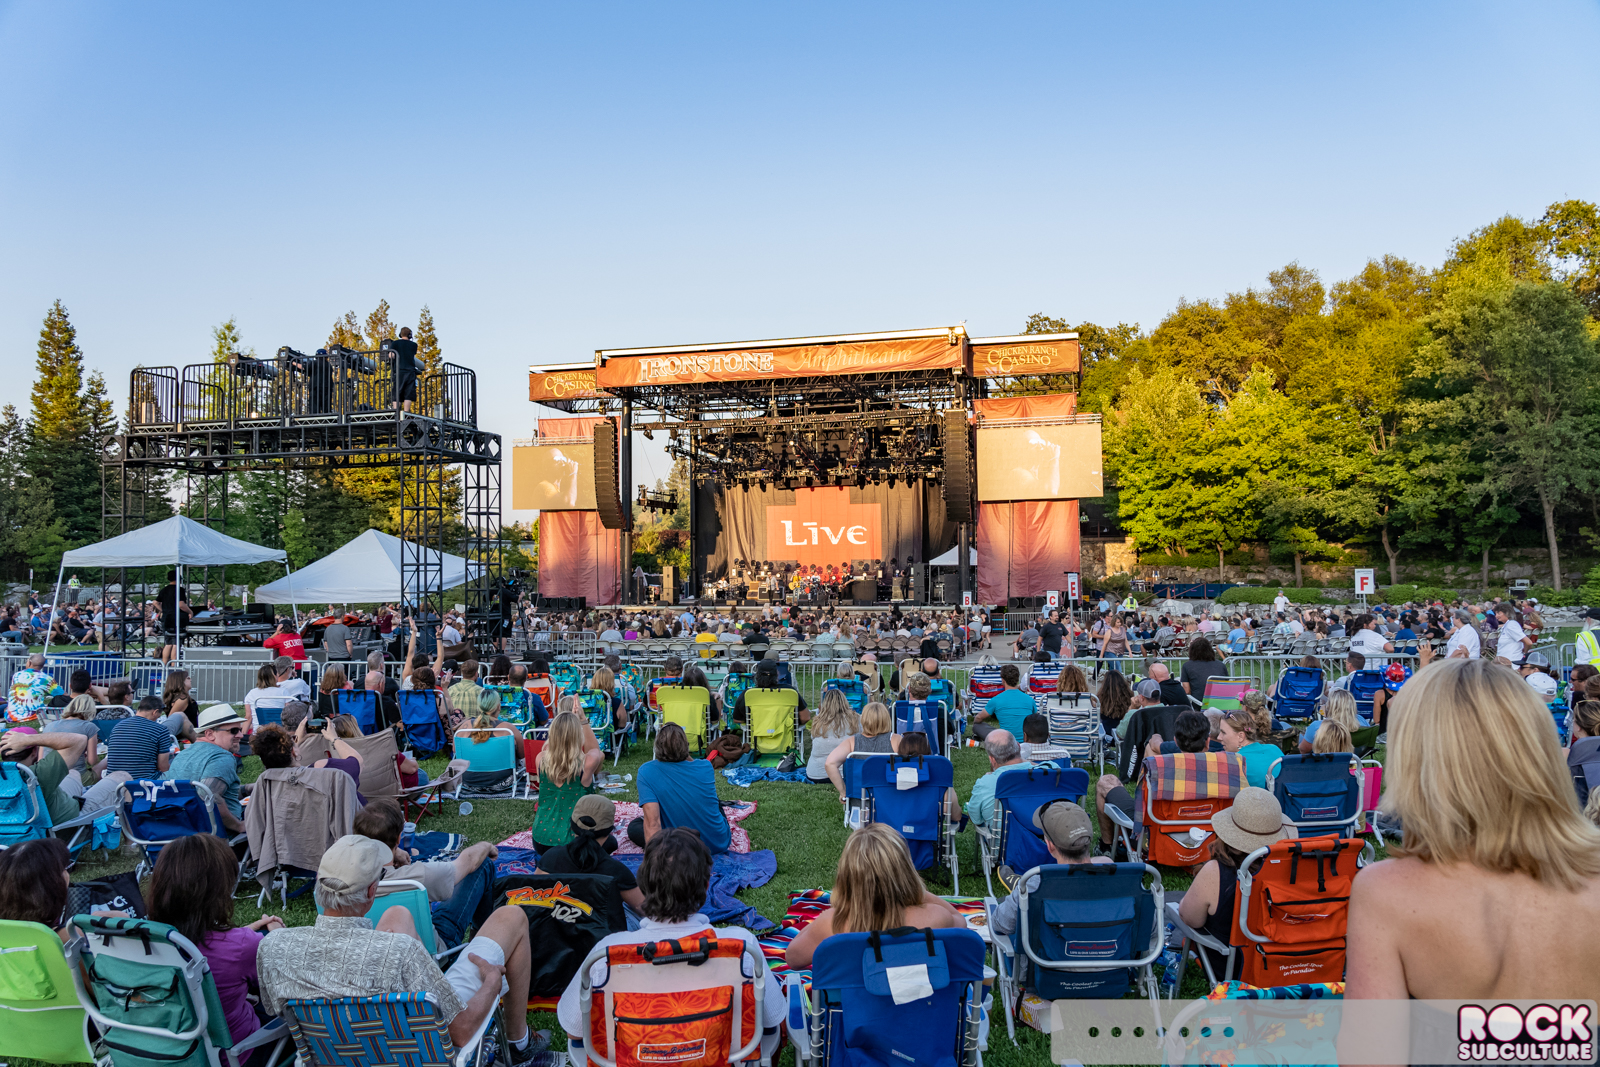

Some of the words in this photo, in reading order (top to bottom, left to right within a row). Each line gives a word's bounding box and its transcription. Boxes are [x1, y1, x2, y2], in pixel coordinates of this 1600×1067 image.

[638, 352, 774, 383] IRONSTONE
[786, 345, 913, 372] Amphitheatre
[987, 345, 1028, 365] CHICKEN
[1029, 345, 1058, 357] RANCH
[999, 354, 1051, 373] CASINO
[544, 372, 577, 390] CHICKEN
[578, 372, 597, 382] RANC
[1070, 581, 1077, 597] E
[1360, 576, 1369, 591] F
[964, 596, 970, 606] B
[1049, 595, 1056, 606] C
[551, 904, 582, 923] 102
